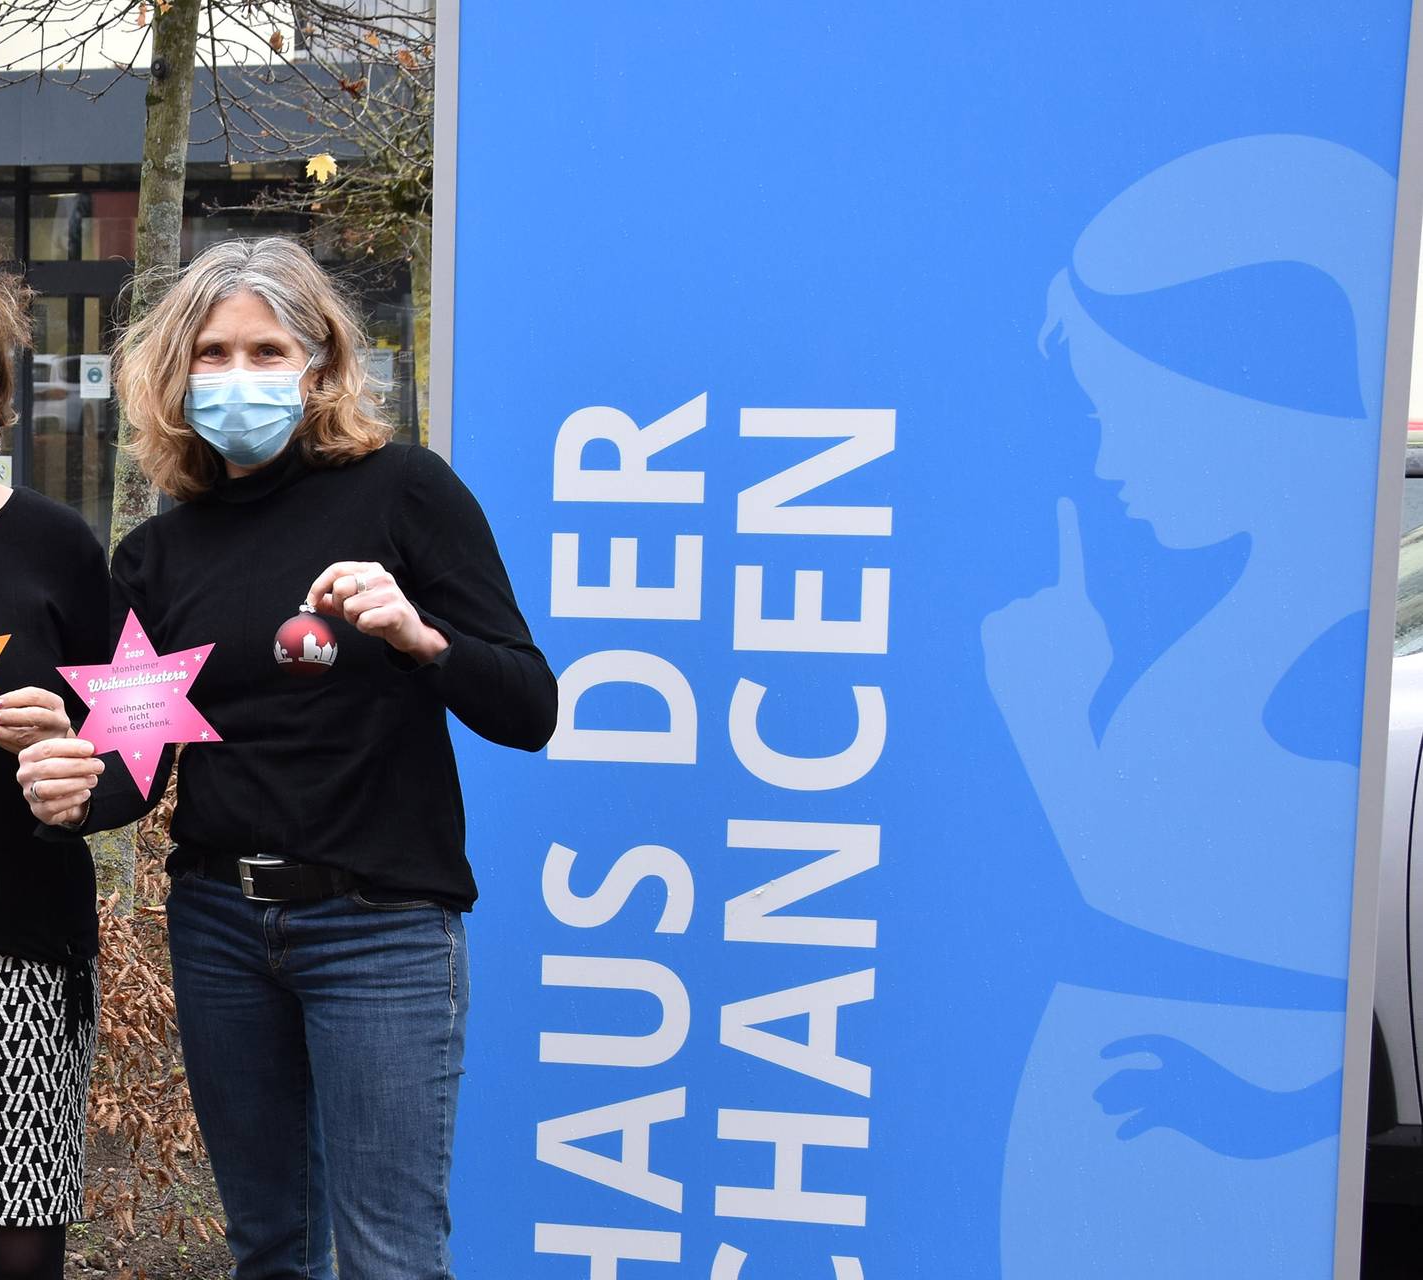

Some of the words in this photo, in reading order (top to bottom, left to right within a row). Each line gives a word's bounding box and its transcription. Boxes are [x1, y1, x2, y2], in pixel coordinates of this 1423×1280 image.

[546, 391, 708, 765] DER
[111, 661, 159, 674] Monheimer
[87, 669, 188, 693] Weihnachtsstern
[110, 701, 165, 714] Weihnachten
[128, 712, 149, 722] nicht
[106, 725, 128, 734] ohne
[129, 718, 172, 731] Geschenk.
